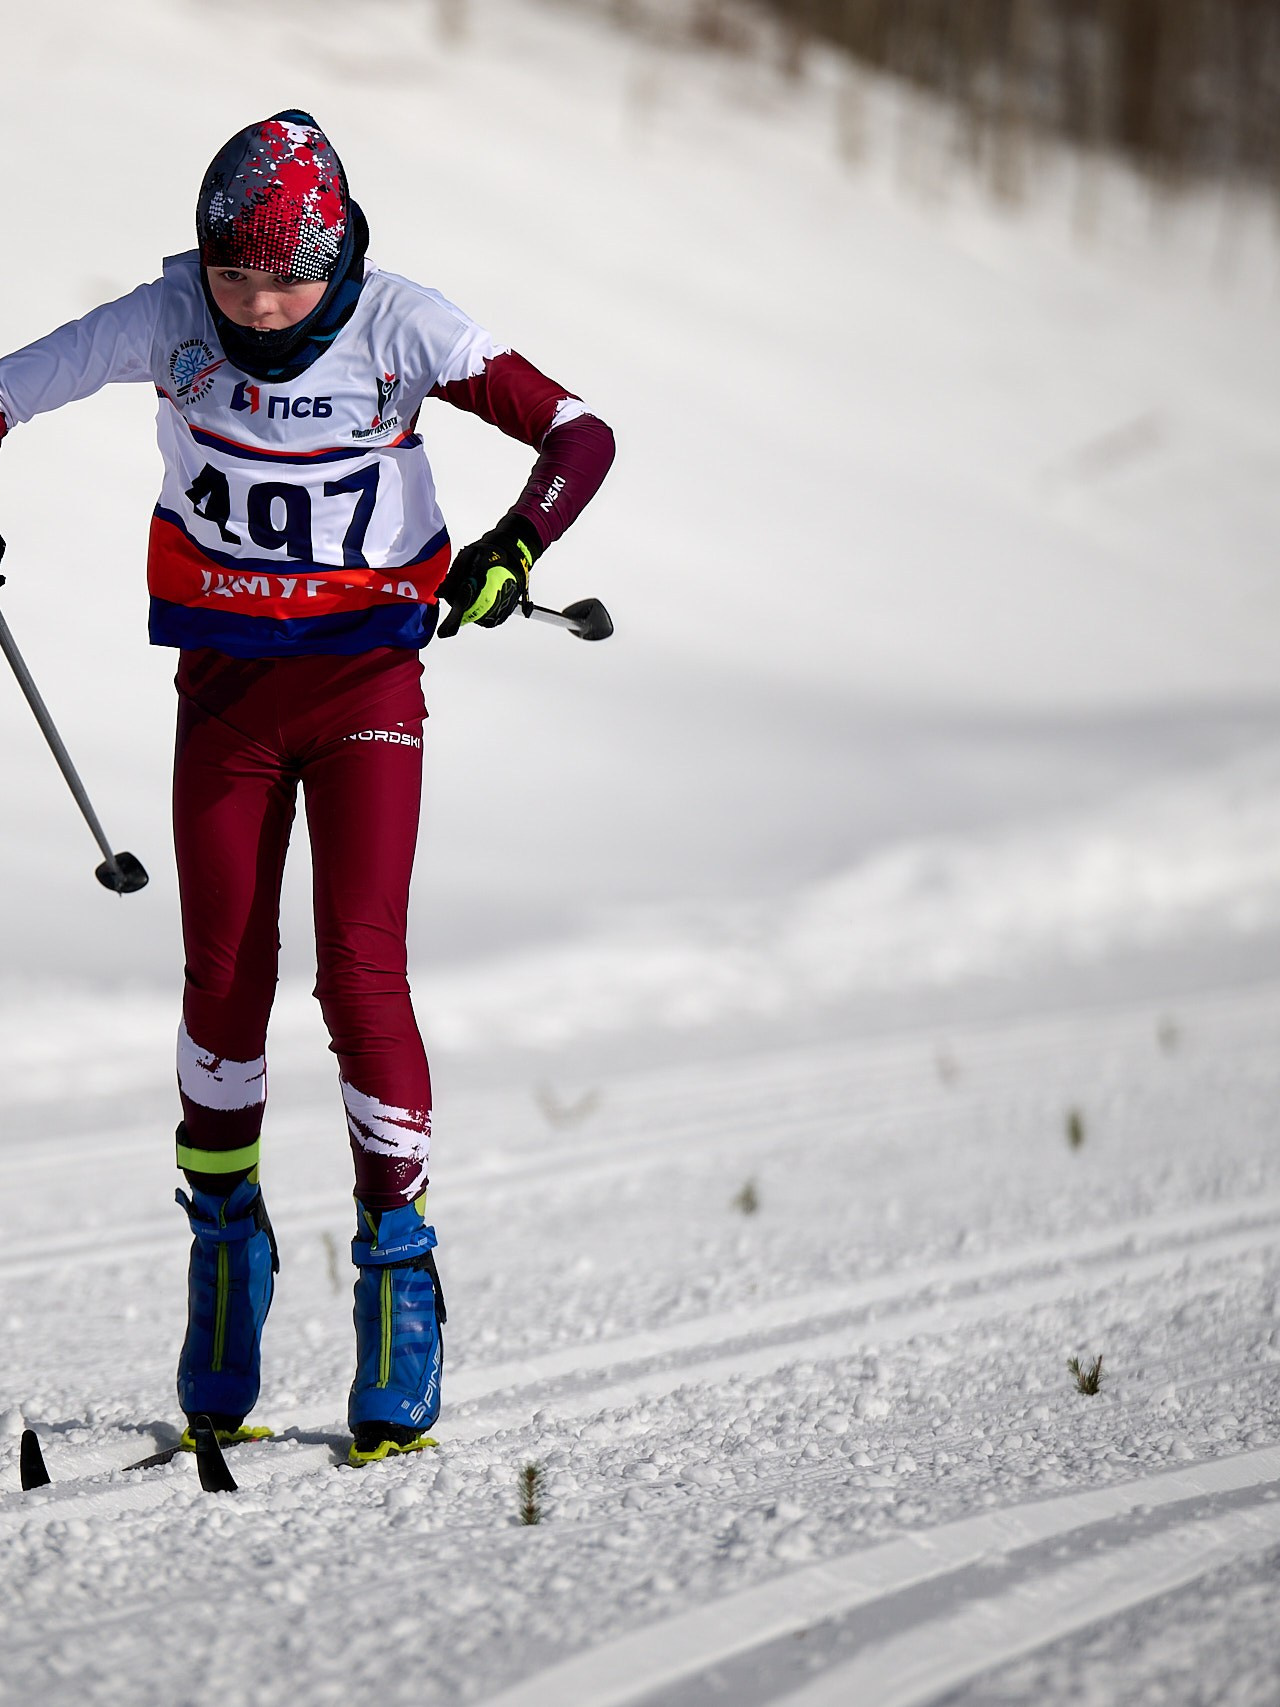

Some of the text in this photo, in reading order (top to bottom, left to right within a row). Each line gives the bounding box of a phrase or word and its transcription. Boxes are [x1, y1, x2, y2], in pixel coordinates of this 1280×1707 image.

[267, 395, 333, 420] ПСБ
[184, 461, 381, 570] 497
[369, 1236, 428, 1257] SPINE
